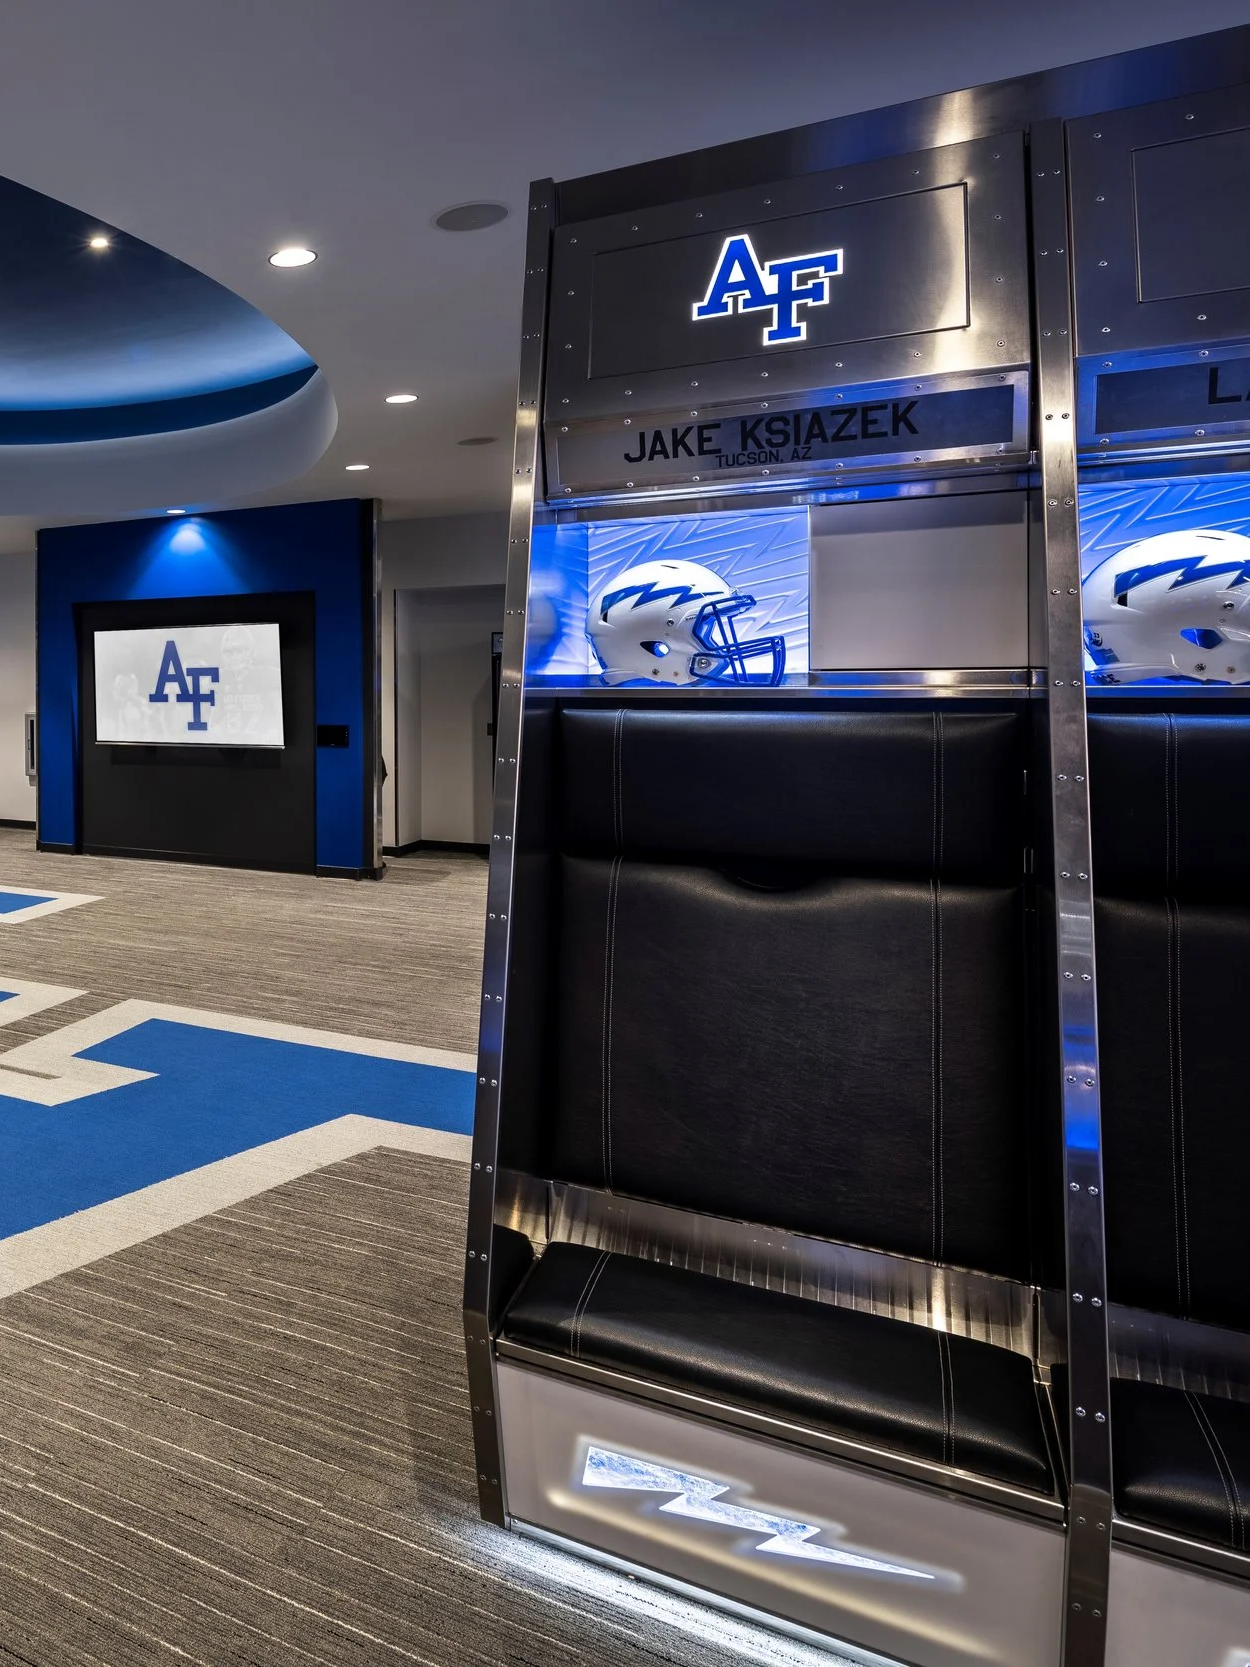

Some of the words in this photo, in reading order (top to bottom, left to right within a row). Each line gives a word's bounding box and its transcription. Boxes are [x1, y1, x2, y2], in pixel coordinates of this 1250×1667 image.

[692, 233, 844, 346] AF
[1208, 367, 1250, 405] L
[623, 422, 722, 463] JAKE
[740, 400, 920, 451] KSIAZEK
[790, 446, 812, 461] AZ
[148, 640, 220, 731] AF
